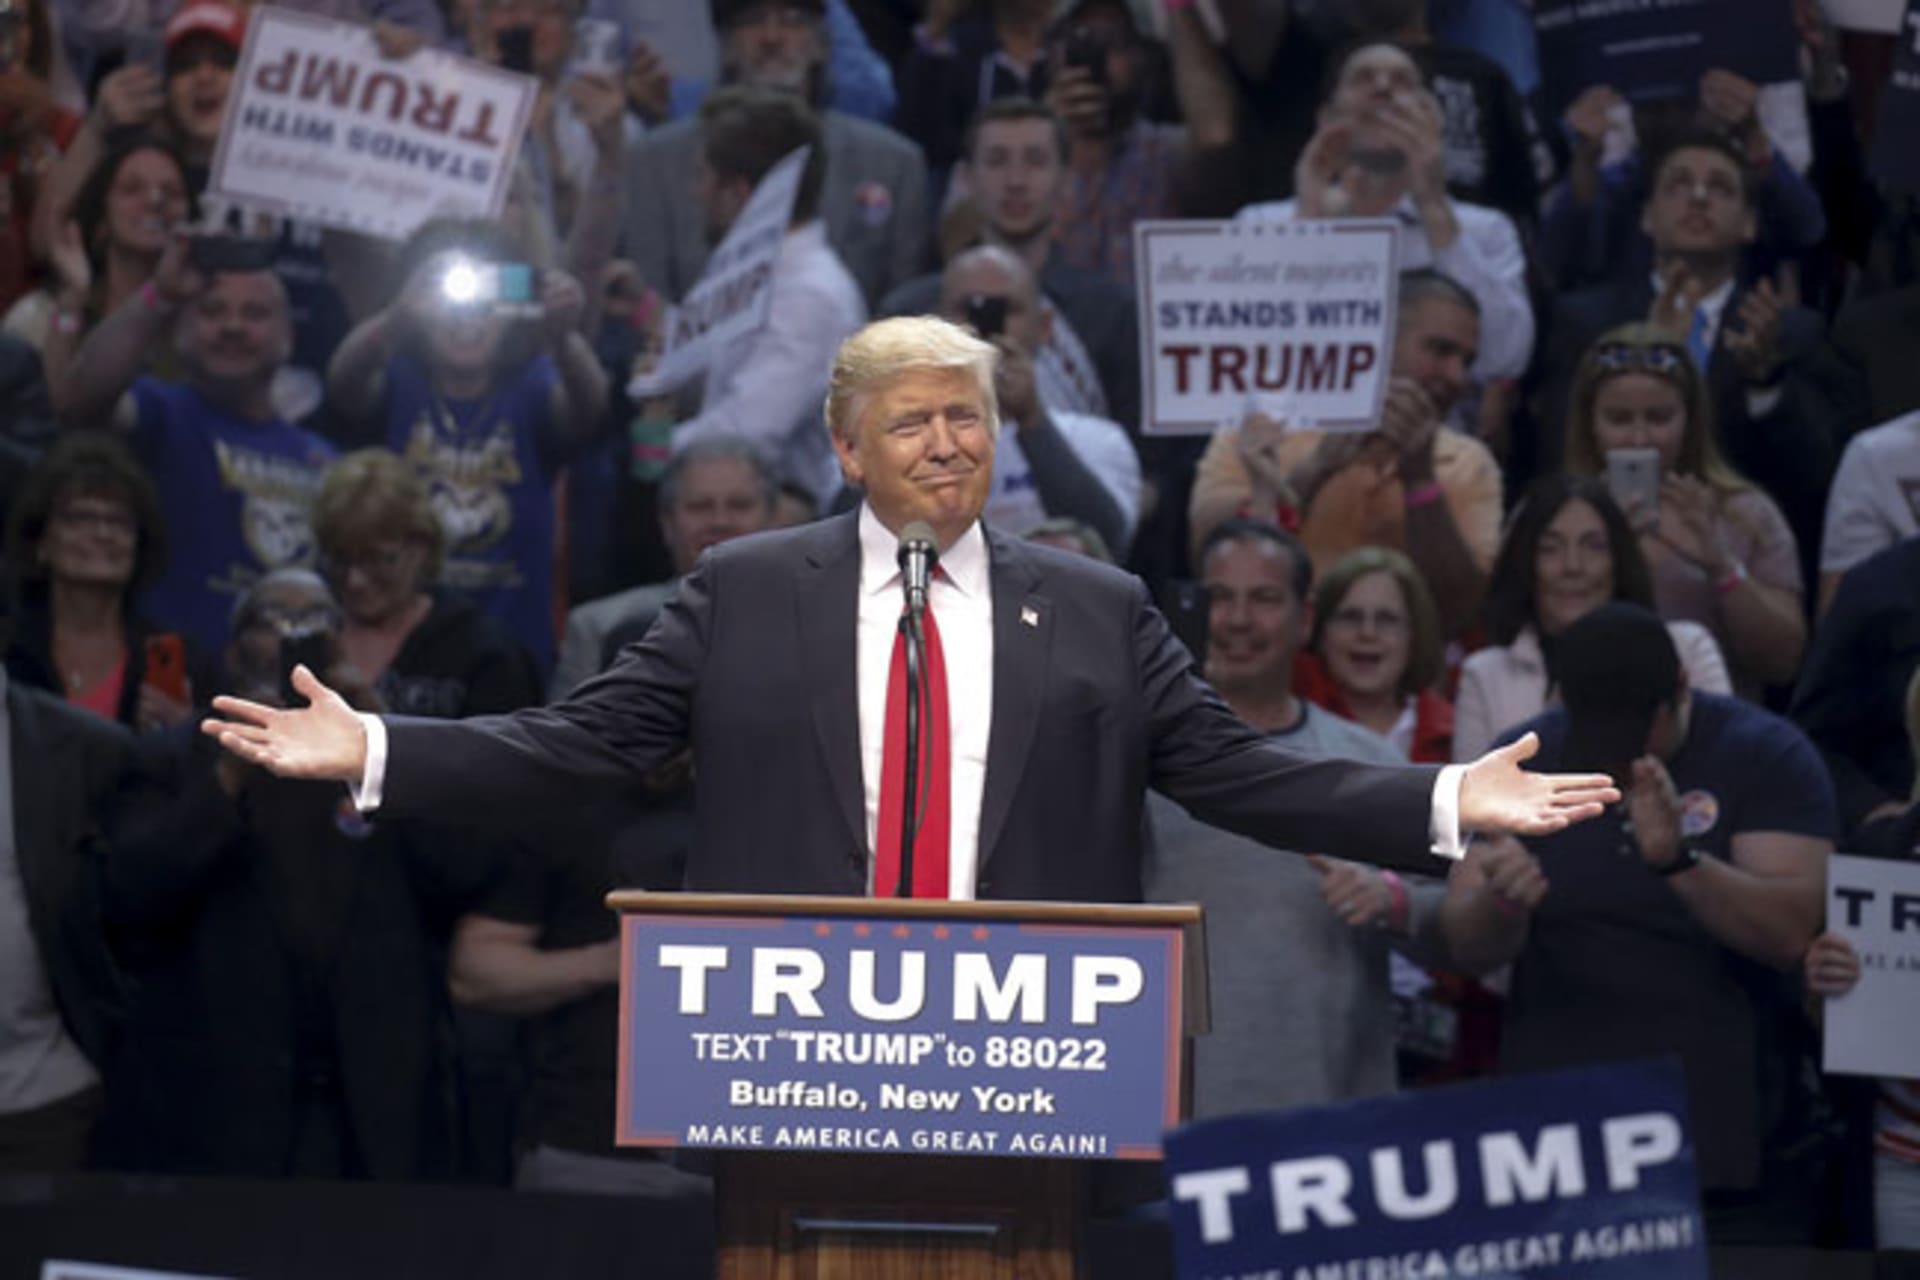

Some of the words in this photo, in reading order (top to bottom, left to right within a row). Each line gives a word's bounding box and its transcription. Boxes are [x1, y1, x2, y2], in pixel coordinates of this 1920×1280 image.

[255, 49, 499, 147] TRUMP
[245, 106, 335, 143] WITH
[348, 127, 490, 184] STANDS
[1159, 301, 1297, 329] STANDS
[1305, 300, 1381, 328] WITH
[1161, 343, 1376, 395] TRUMP
[658, 944, 1144, 1025] TRUMP
[691, 1032, 772, 1062] TEXT
[946, 1041, 976, 1068] to
[985, 1037, 1107, 1071] 88022
[730, 1079, 867, 1112] Buffalo,
[880, 1084, 960, 1112] New
[971, 1085, 1056, 1115] York
[687, 1125, 764, 1147] MAKE
[775, 1127, 900, 1149] AMERICA
[912, 1130, 1000, 1152] GREAT
[1010, 1133, 1107, 1155] AGAIN!
[1173, 1111, 1683, 1243] TRUMP
[1454, 1232, 1563, 1277] GREAT
[1571, 1215, 1694, 1263] AGAIN!
